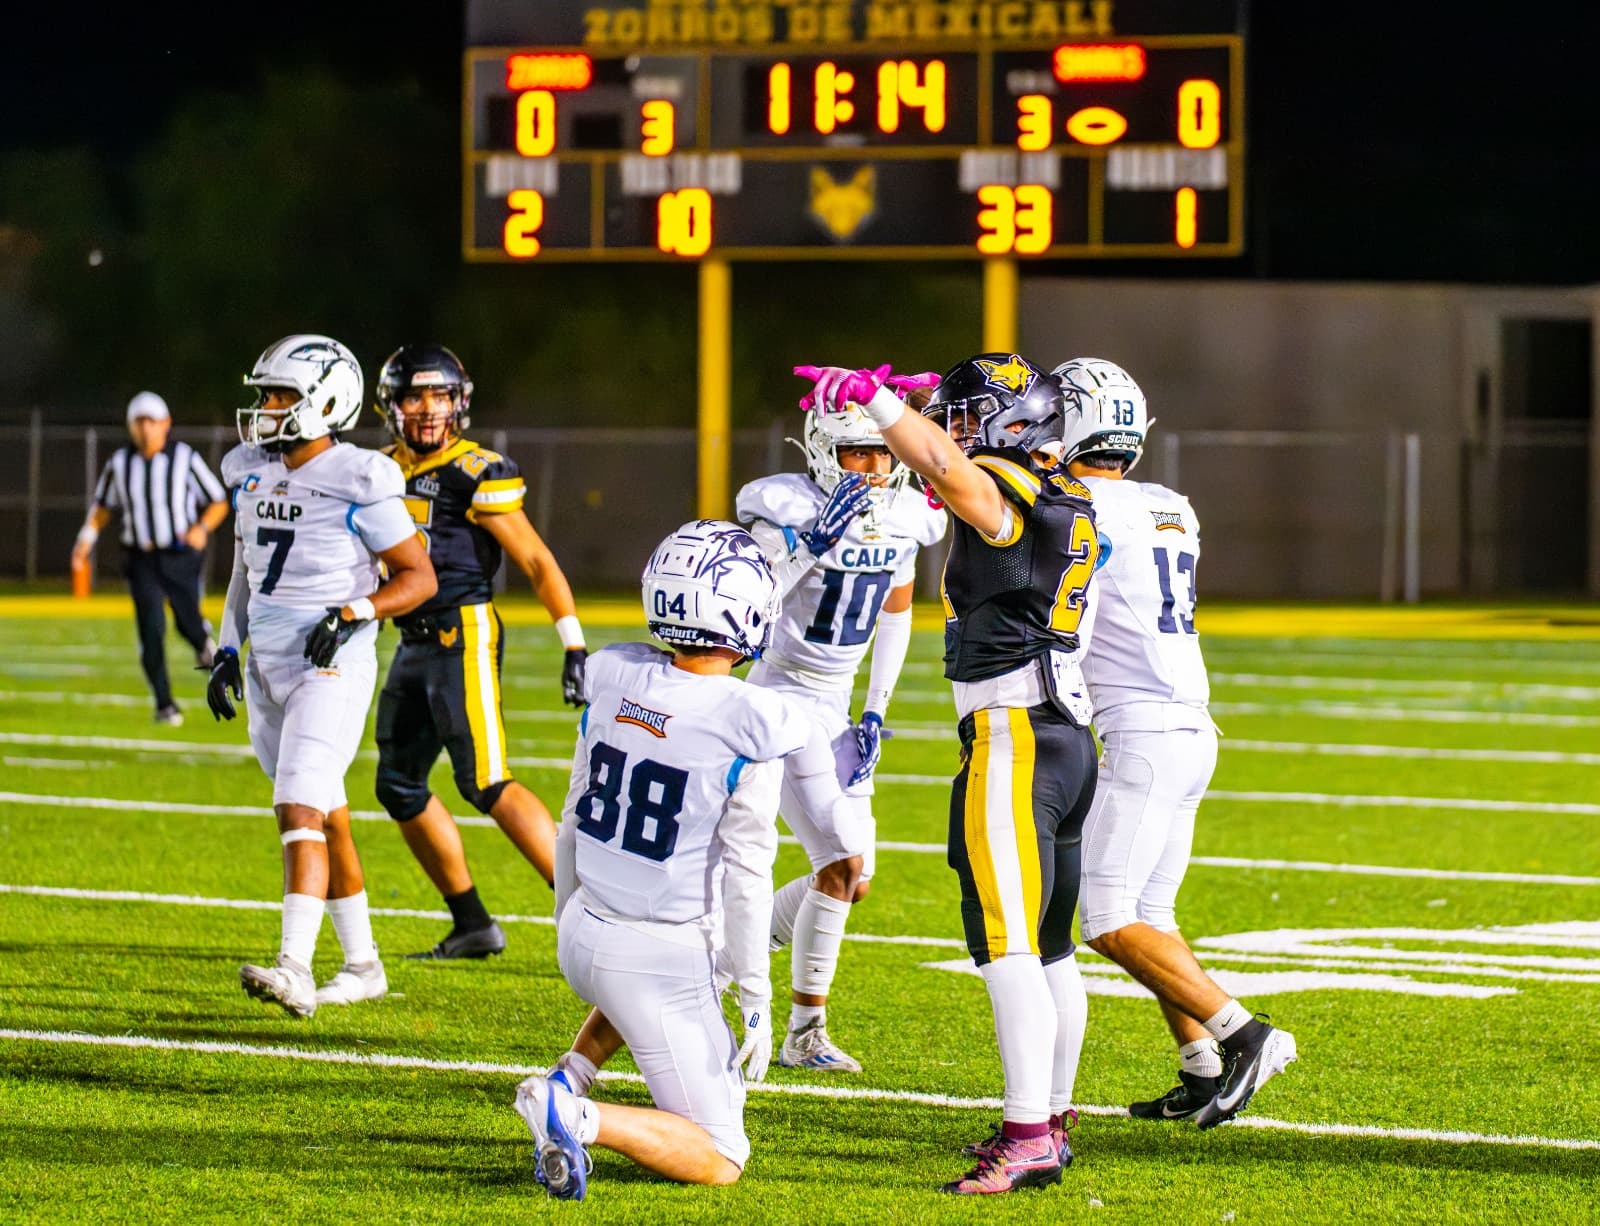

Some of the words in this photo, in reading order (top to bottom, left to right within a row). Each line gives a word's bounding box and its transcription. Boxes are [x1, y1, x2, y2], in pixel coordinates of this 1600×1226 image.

[583, 6, 772, 43] ZORROS
[788, 4, 853, 42] DE
[866, 1, 1113, 38] MEXICALI
[516, 90, 555, 156] 0
[641, 100, 674, 156] 3
[769, 60, 946, 135] 11:14
[1018, 95, 1052, 151] 3
[1178, 79, 1220, 148] 0
[504, 189, 543, 257] 2
[658, 188, 711, 256] 10
[977, 184, 1052, 254] 33
[1176, 187, 1197, 249] 1
[256, 501, 303, 522] CALP
[257, 526, 295, 596] 7
[842, 548, 897, 567] CALP
[1152, 547, 1197, 634] 13
[654, 589, 687, 621] 04
[659, 625, 698, 640] schutt
[804, 570, 893, 646] 10
[619, 700, 666, 730] SHARKS
[575, 741, 689, 862] 88
